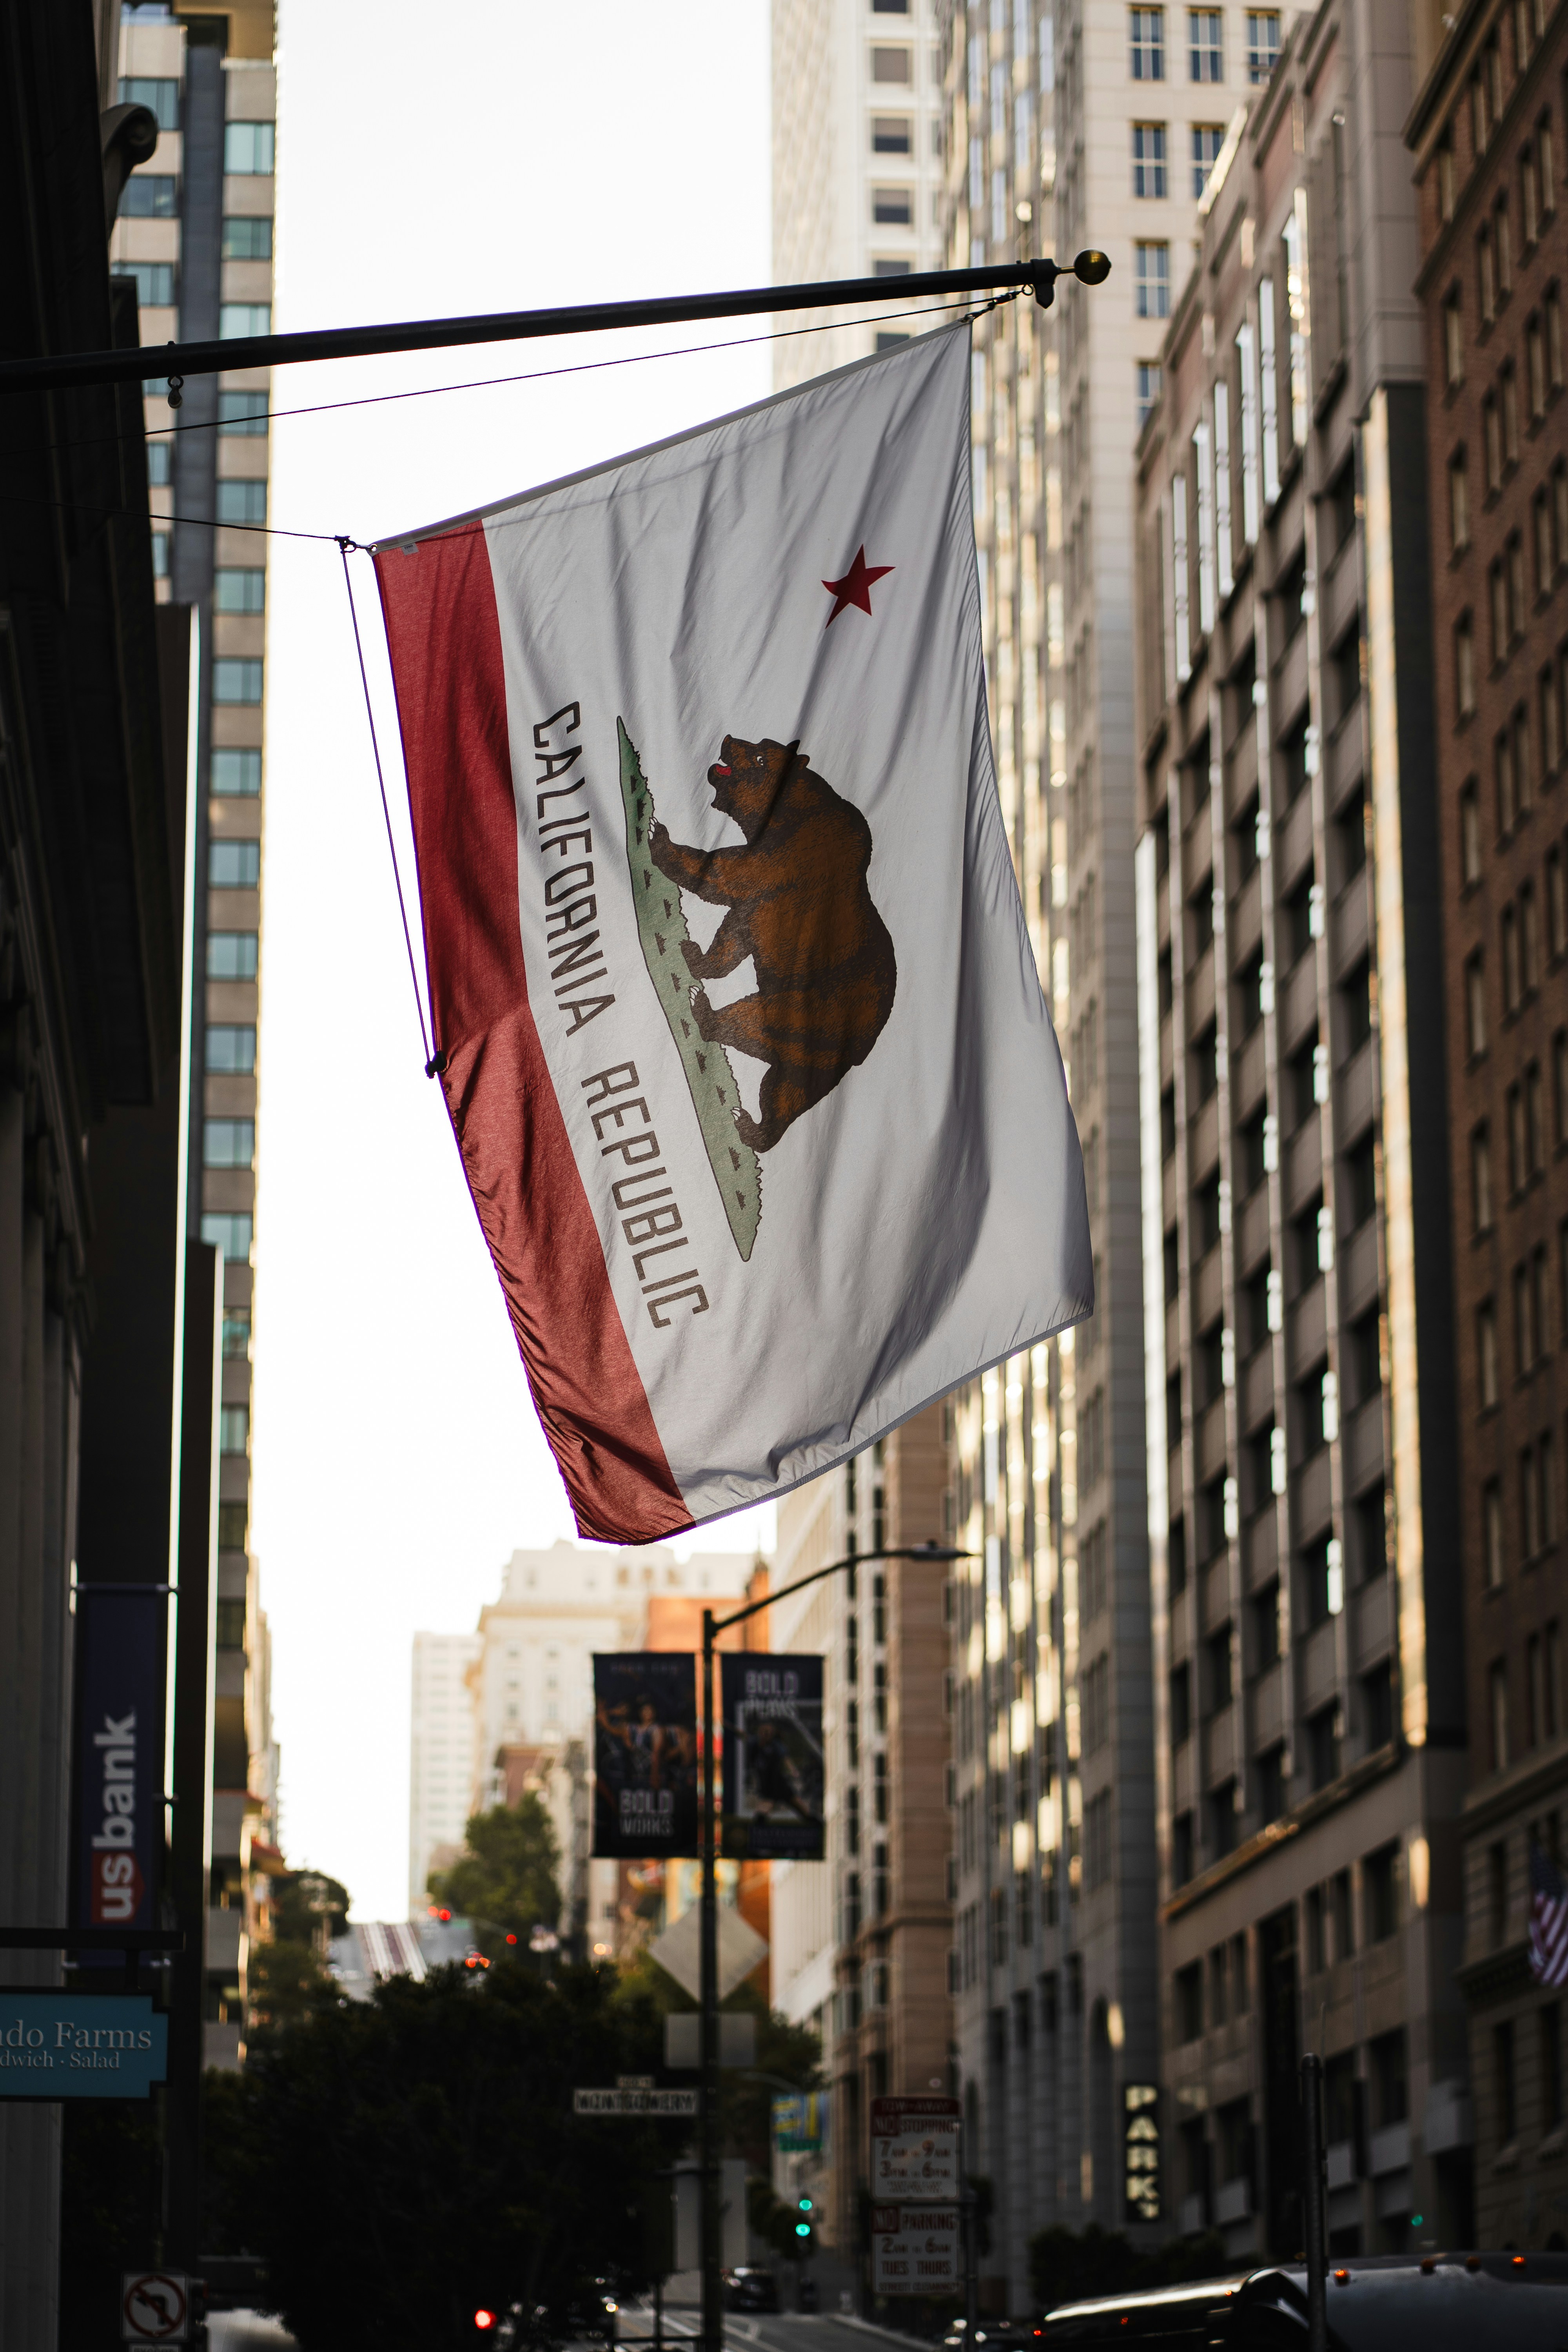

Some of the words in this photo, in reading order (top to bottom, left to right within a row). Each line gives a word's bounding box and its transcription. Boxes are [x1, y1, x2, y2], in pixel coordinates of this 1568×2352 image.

[533, 701, 616, 1036] CALIFORNIA
[580, 1060, 710, 1329] REPUBLIC
[744, 1670, 799, 1694] BOLD
[619, 1789, 673, 1814] BOLD
[620, 1817, 673, 1837] WORKS
[54, 2022, 152, 2050] Farms
[70, 2051, 120, 2069] Salad
[579, 2094, 694, 2110] MONTGOMERY
[881, 2101, 950, 2112] TOW-AWAY
[875, 2116, 895, 2134] NO
[902, 2119, 955, 2133] STOPPING
[1126, 2085, 1160, 2200] PARK
[874, 2208, 897, 2230] NO
[902, 2213, 954, 2230] PARKING
[882, 2259, 909, 2275] TUES
[917, 2259, 951, 2275] THURS
